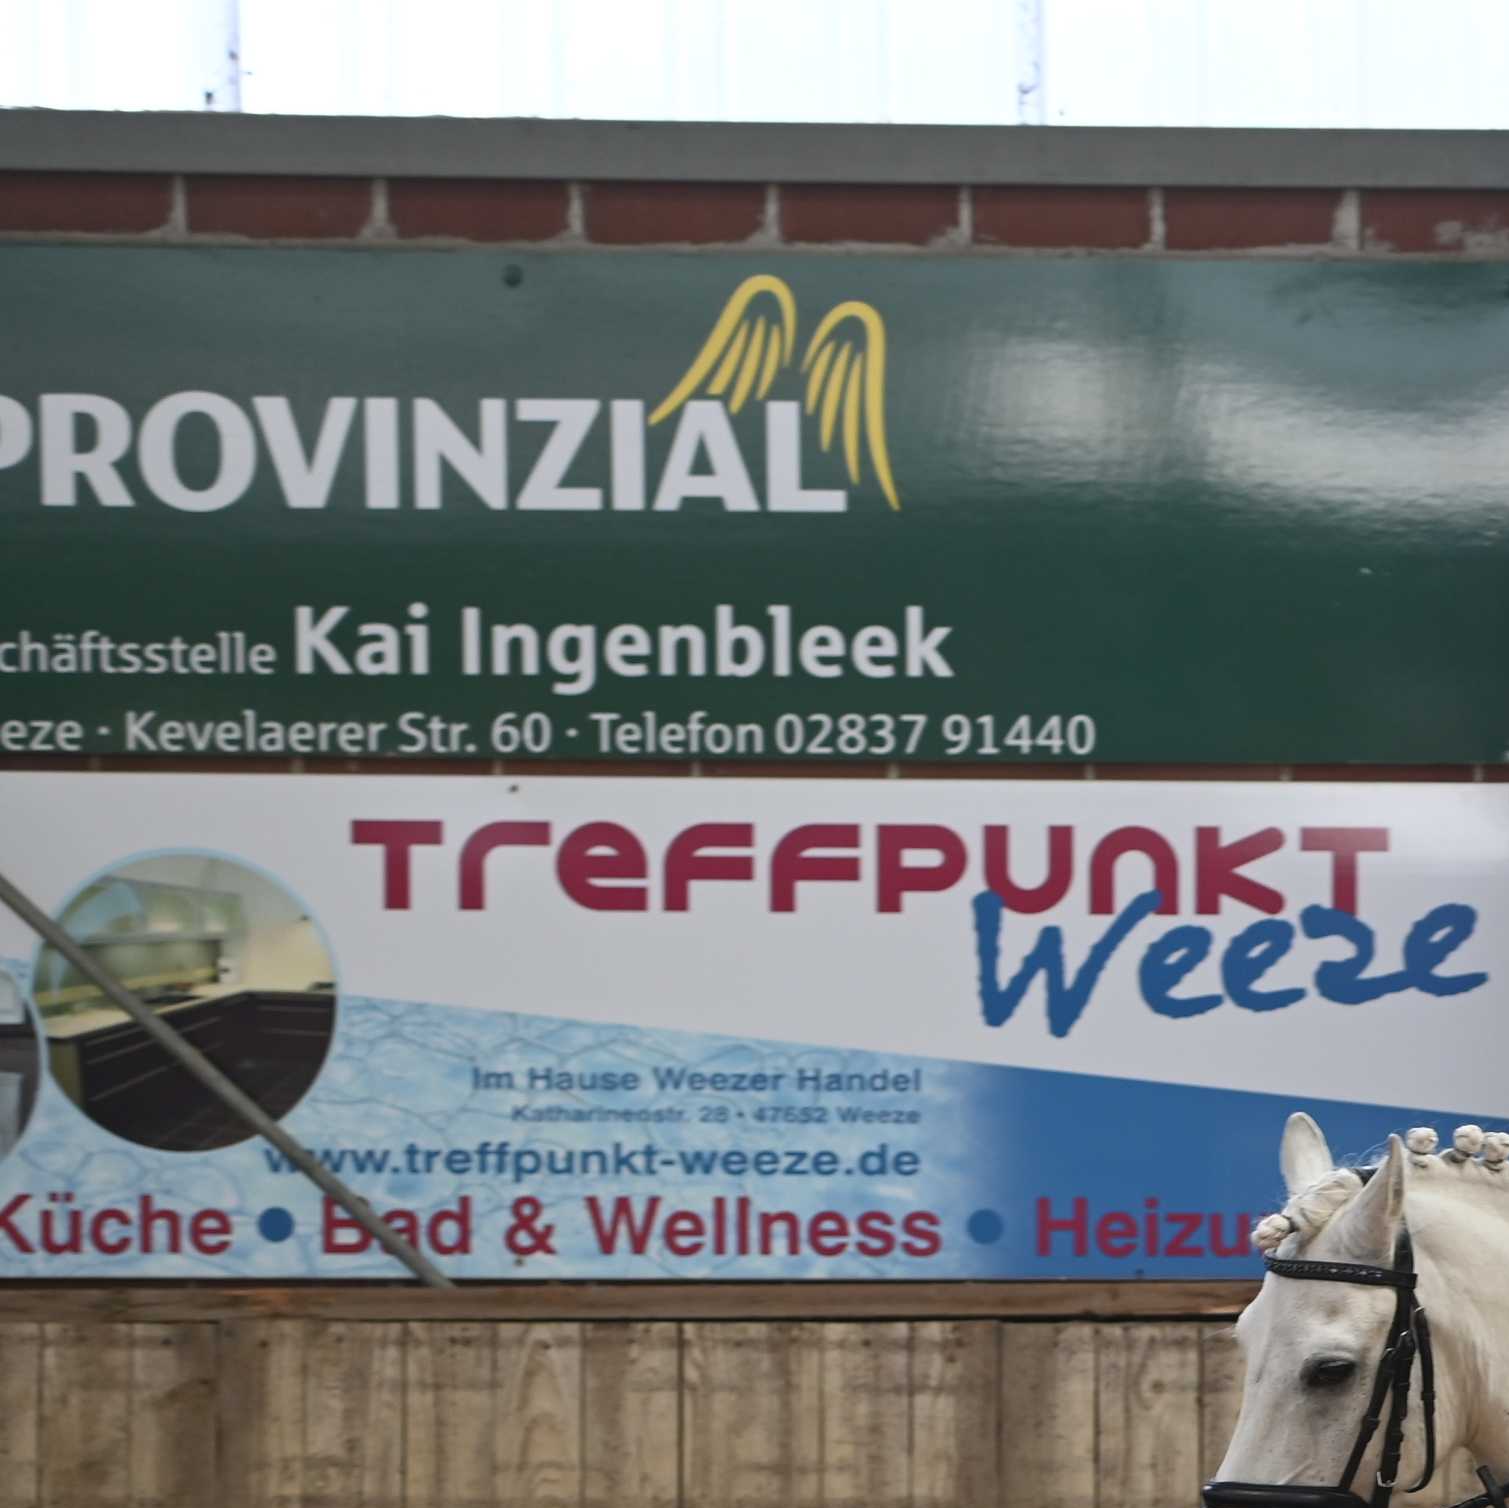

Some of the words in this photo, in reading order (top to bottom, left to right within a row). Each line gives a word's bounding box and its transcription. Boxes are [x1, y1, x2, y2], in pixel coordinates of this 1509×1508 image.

[295, 602, 431, 676] Kai
[462, 604, 955, 694] Ingenbleek
[0, 719, 84, 752] eze
[124, 711, 387, 754] Kevelaerer
[397, 713, 478, 754] Str.
[489, 713, 552, 754] 60
[590, 711, 764, 754] Telefon
[775, 714, 928, 754] 02837
[941, 714, 1097, 754] 91440
[972, 888, 1489, 1038] Weeze
[472, 1067, 513, 1092] Im
[528, 1067, 639, 1092] Hause
[652, 1067, 783, 1092] Weezer
[797, 1067, 921, 1092] Handel
[839, 1105, 921, 1124] Weeze
[264, 1140, 921, 1183] www.treffpunkt-weeze.de
[0, 1190, 233, 1255] Küche
[322, 1194, 472, 1255] Bad
[503, 1196, 556, 1256] &
[585, 1194, 943, 1258] Wellness
[1035, 1197, 1270, 1258] Heizu
